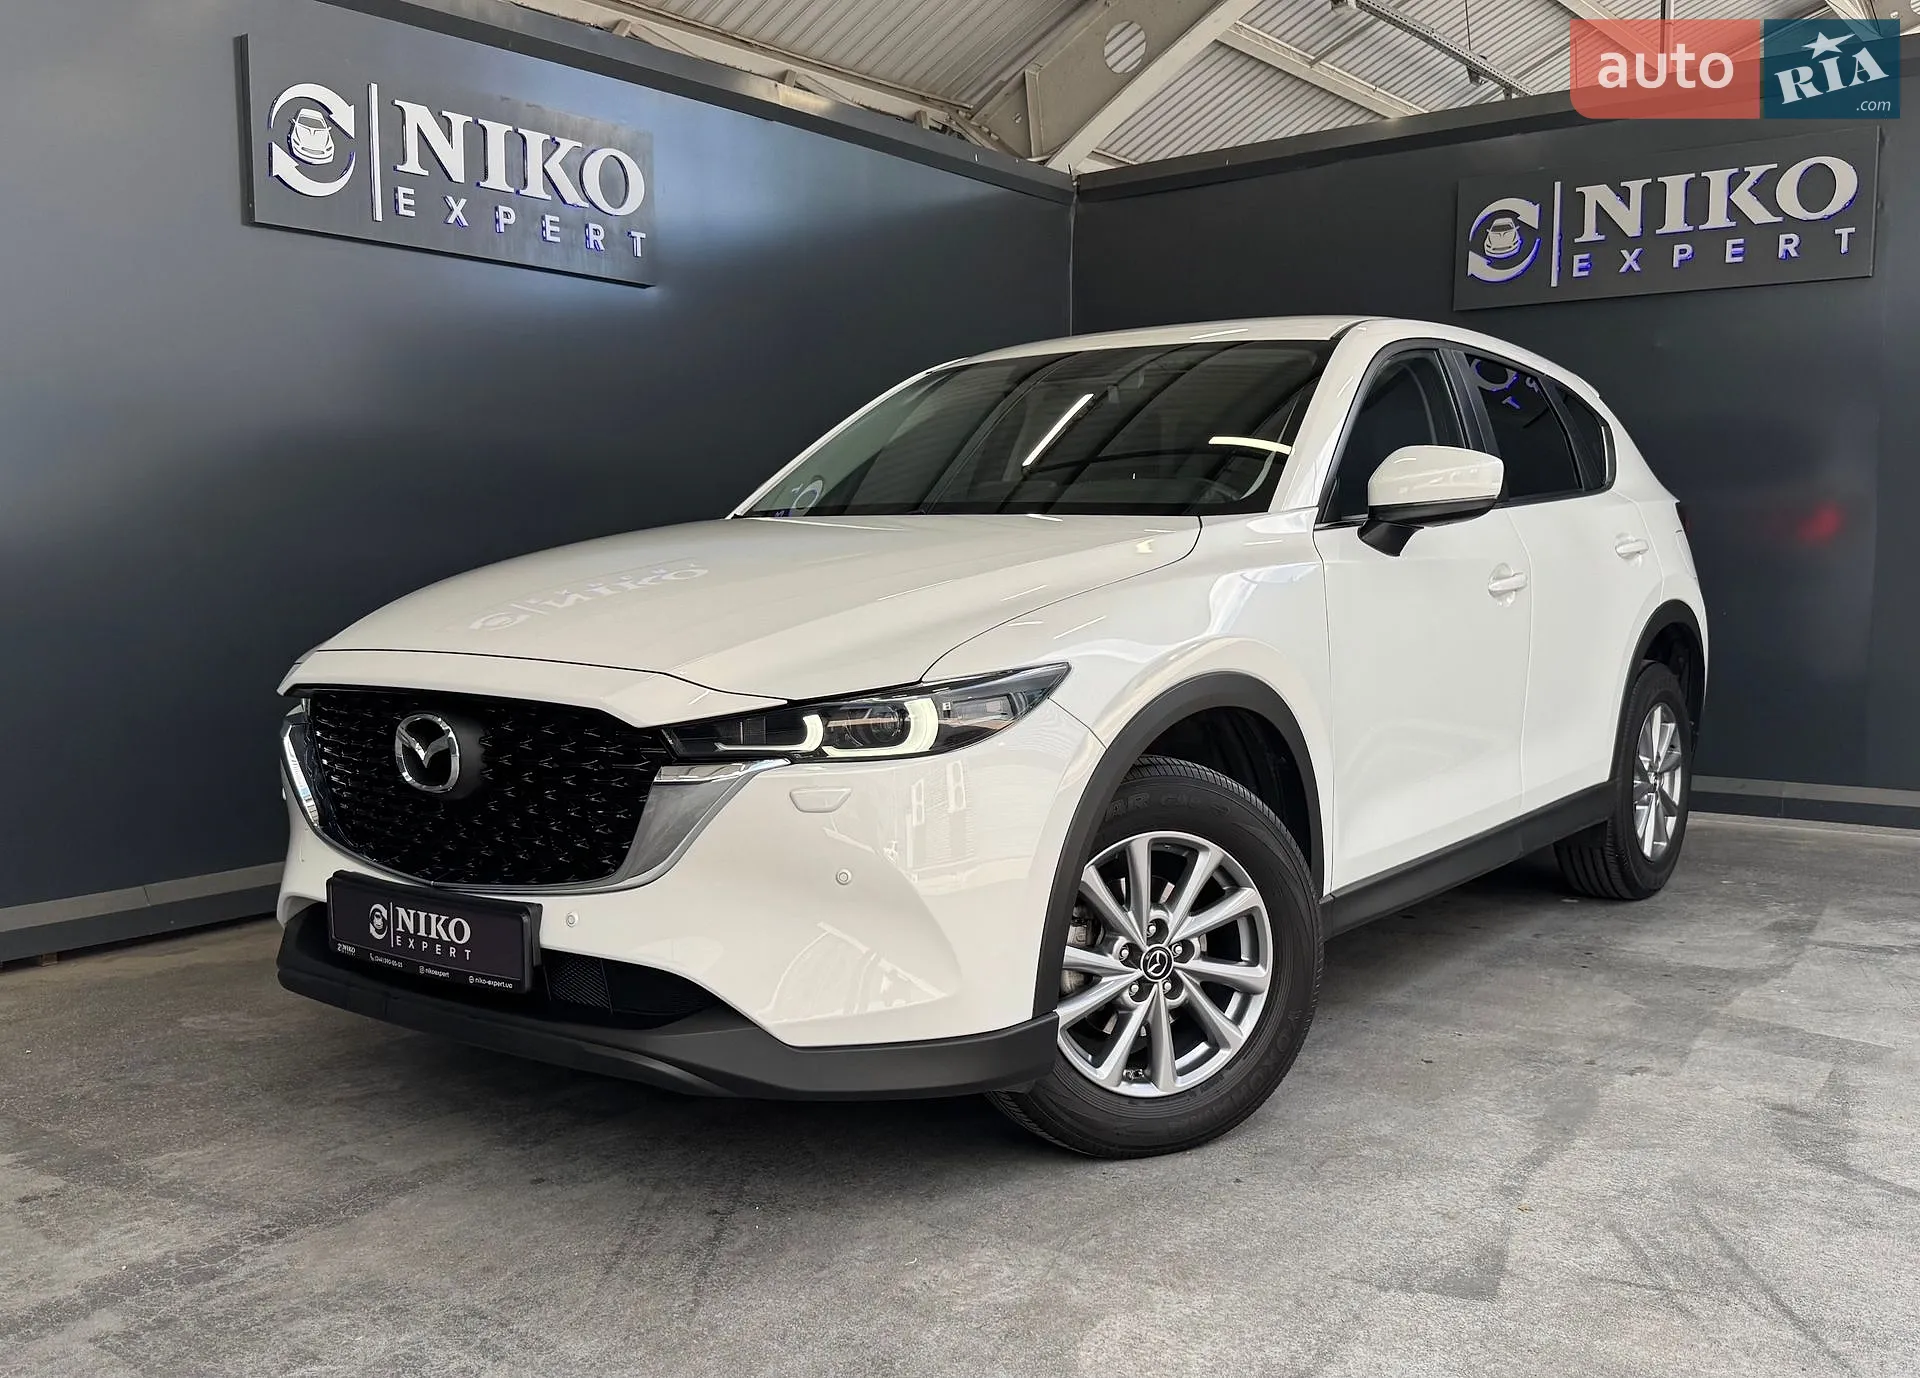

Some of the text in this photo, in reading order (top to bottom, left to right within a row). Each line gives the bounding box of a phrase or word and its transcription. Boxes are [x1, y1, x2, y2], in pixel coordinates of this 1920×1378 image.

[391, 98, 645, 216] NIKO
[394, 185, 646, 258] EXPERT
[1574, 155, 1858, 244] NIKO
[1572, 227, 1856, 279] EXPERT
[395, 906, 471, 945] NIKO
[396, 935, 471, 961] EXPERT
